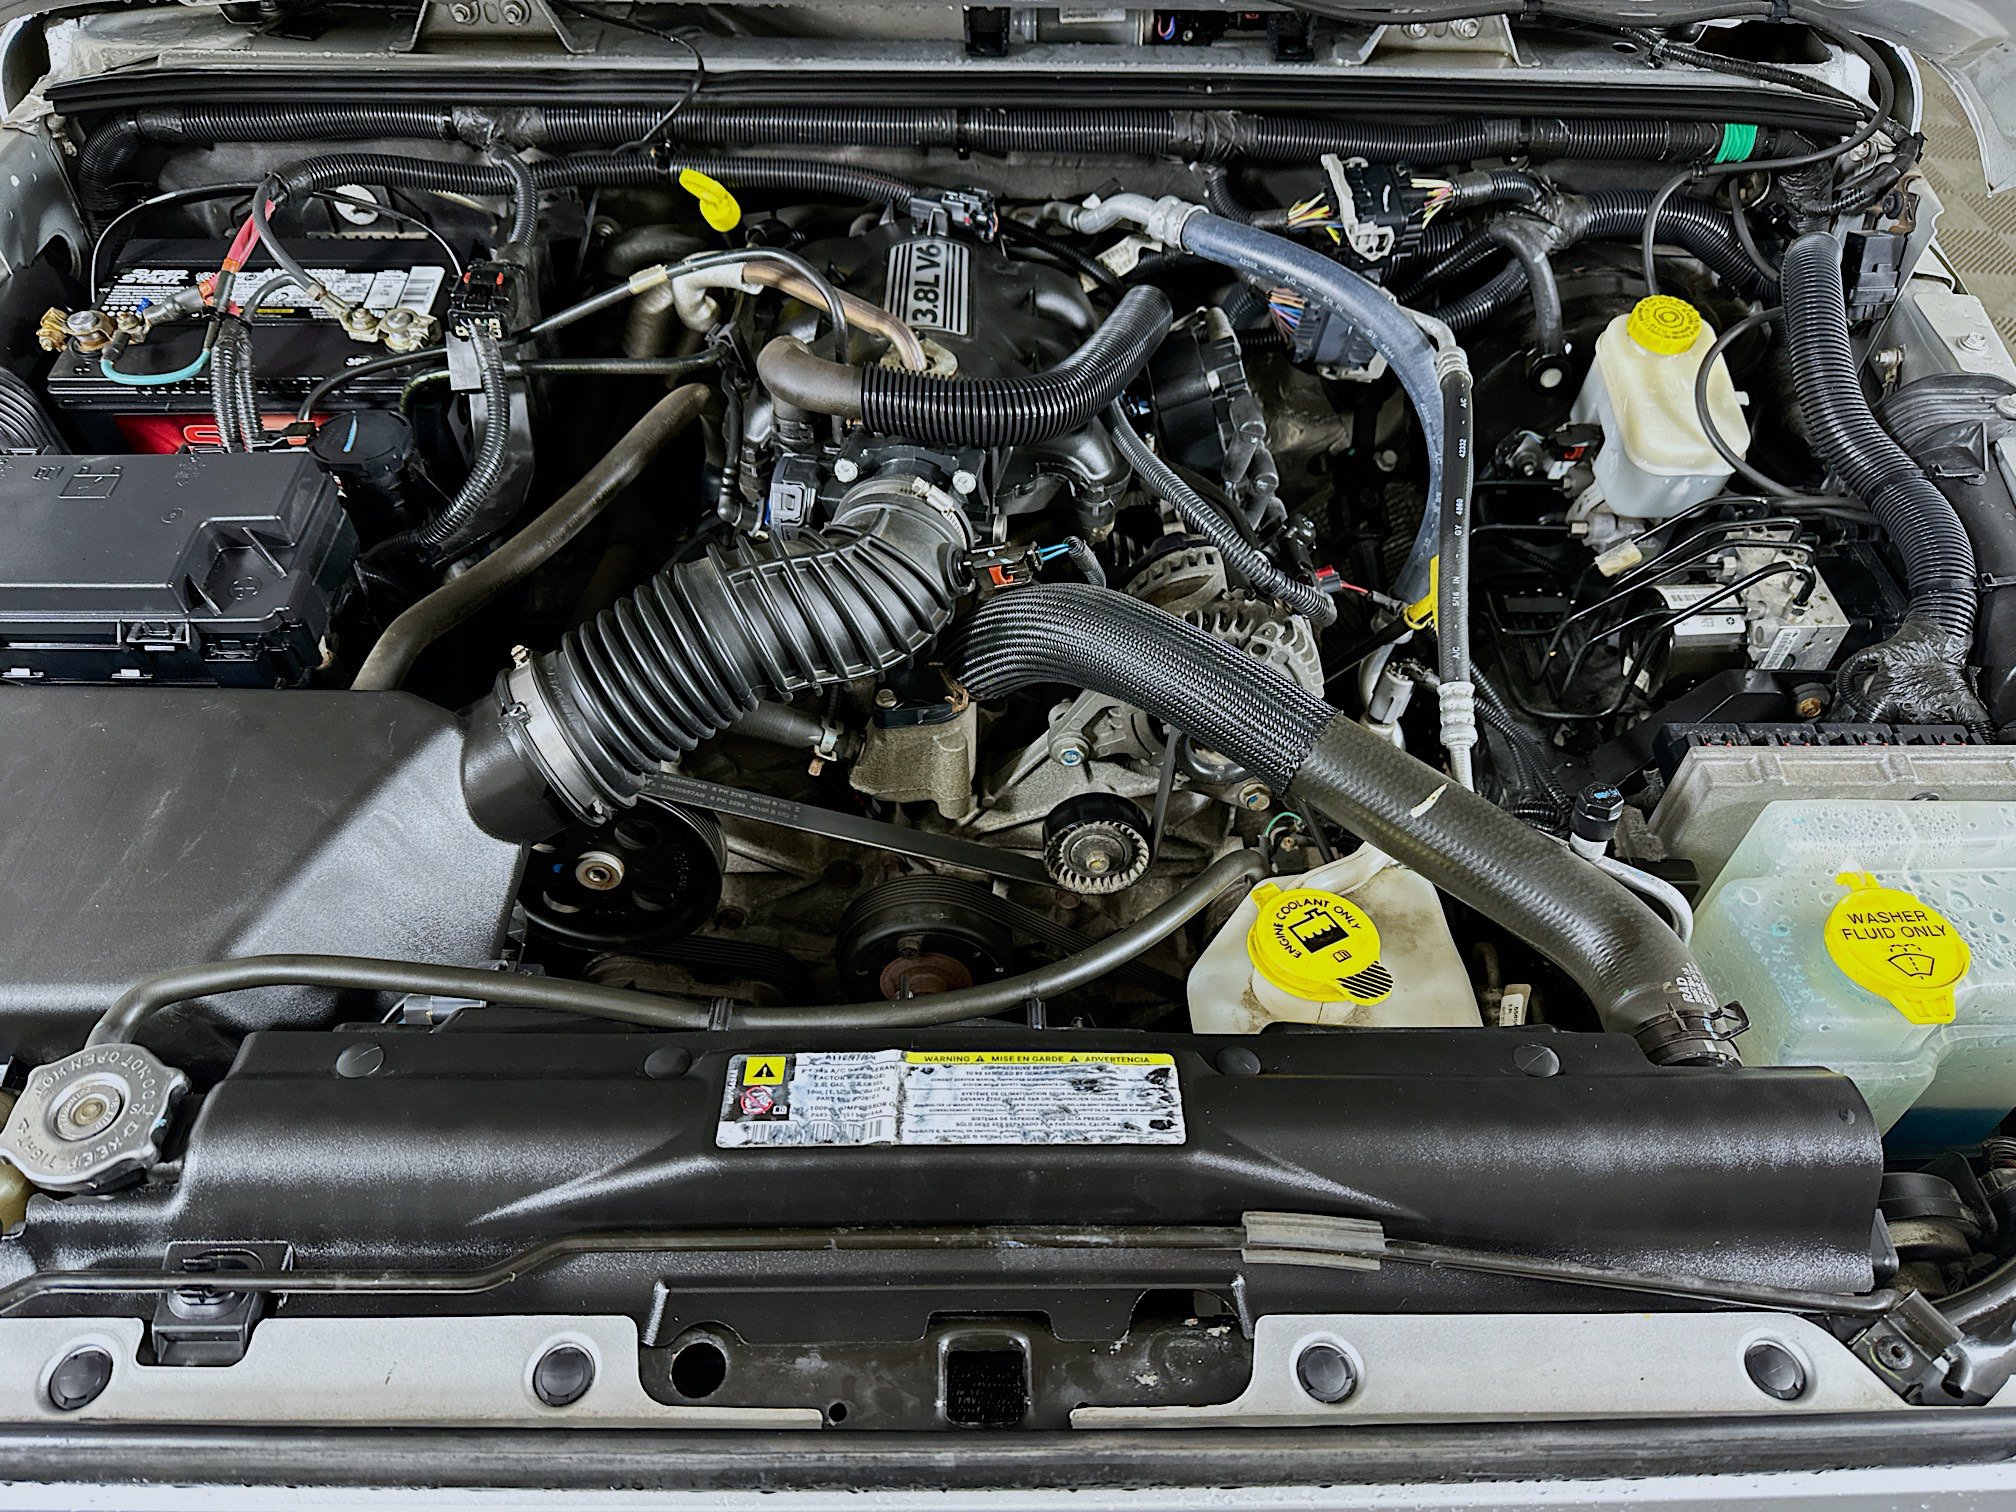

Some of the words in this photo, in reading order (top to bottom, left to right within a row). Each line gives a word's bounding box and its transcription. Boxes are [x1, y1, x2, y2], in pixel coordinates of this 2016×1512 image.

[916, 244, 942, 272] V6
[912, 274, 940, 323] 3.8L
[1458, 438, 1467, 458] 42332
[1454, 525, 1462, 536] GY
[1453, 576, 1460, 584] IN
[1452, 591, 1460, 607] 5/16
[1452, 646, 1460, 659] A/C
[1276, 898, 1330, 920] COOLANT
[1333, 905, 1361, 930] ONLY
[1847, 910, 1928, 925] WASHER
[1273, 923, 1302, 959] ENGINE
[1841, 927, 1896, 940] FLUID
[1901, 925, 1946, 939] ONLY
[1675, 976, 1696, 1003] RAD
[71, 1051, 120, 1070] OPEN
[121, 1054, 151, 1080] NOT
[36, 1067, 67, 1097] HOT
[142, 1077, 156, 1101] DO
[17, 1136, 57, 1169] TIGHT
[67, 1136, 123, 1172] KEEP
